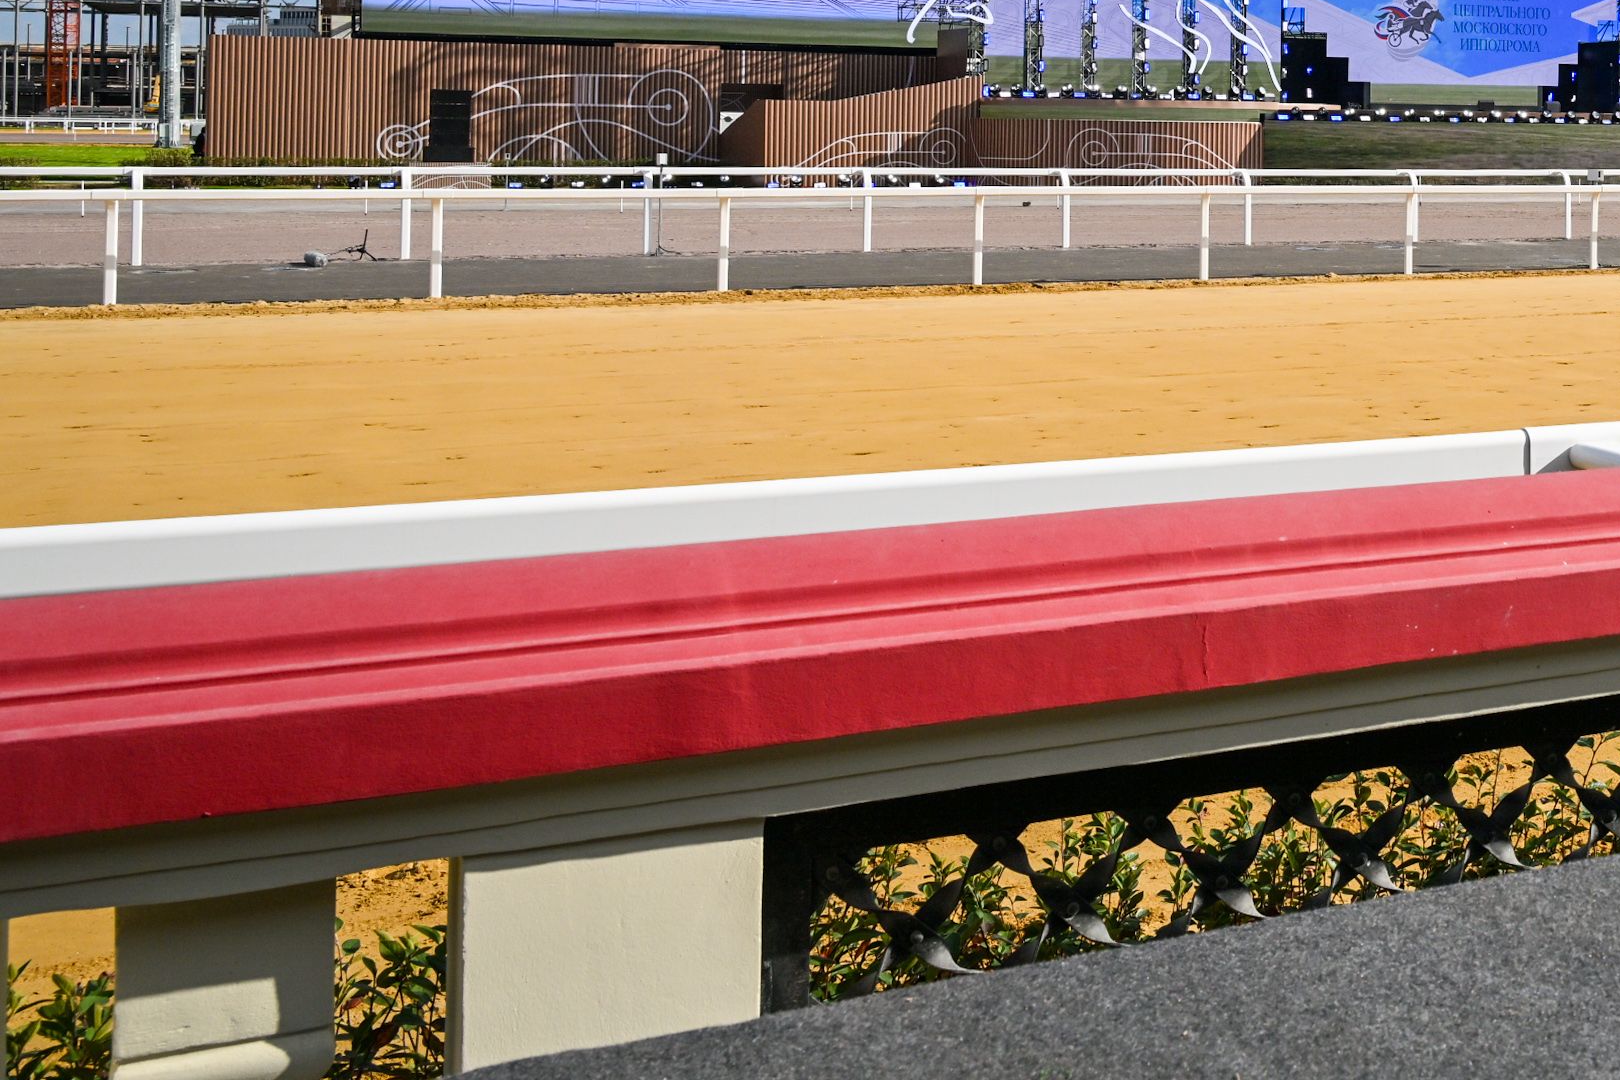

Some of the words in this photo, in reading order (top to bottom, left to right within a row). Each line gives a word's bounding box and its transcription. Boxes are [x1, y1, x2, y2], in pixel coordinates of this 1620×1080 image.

[1453, 3, 1550, 20] ЦЕНТРАЛЬНОГО
[1453, 21, 1548, 37] МОСКОВСКОГО
[1460, 38, 1541, 53] ИППОДРОМА
